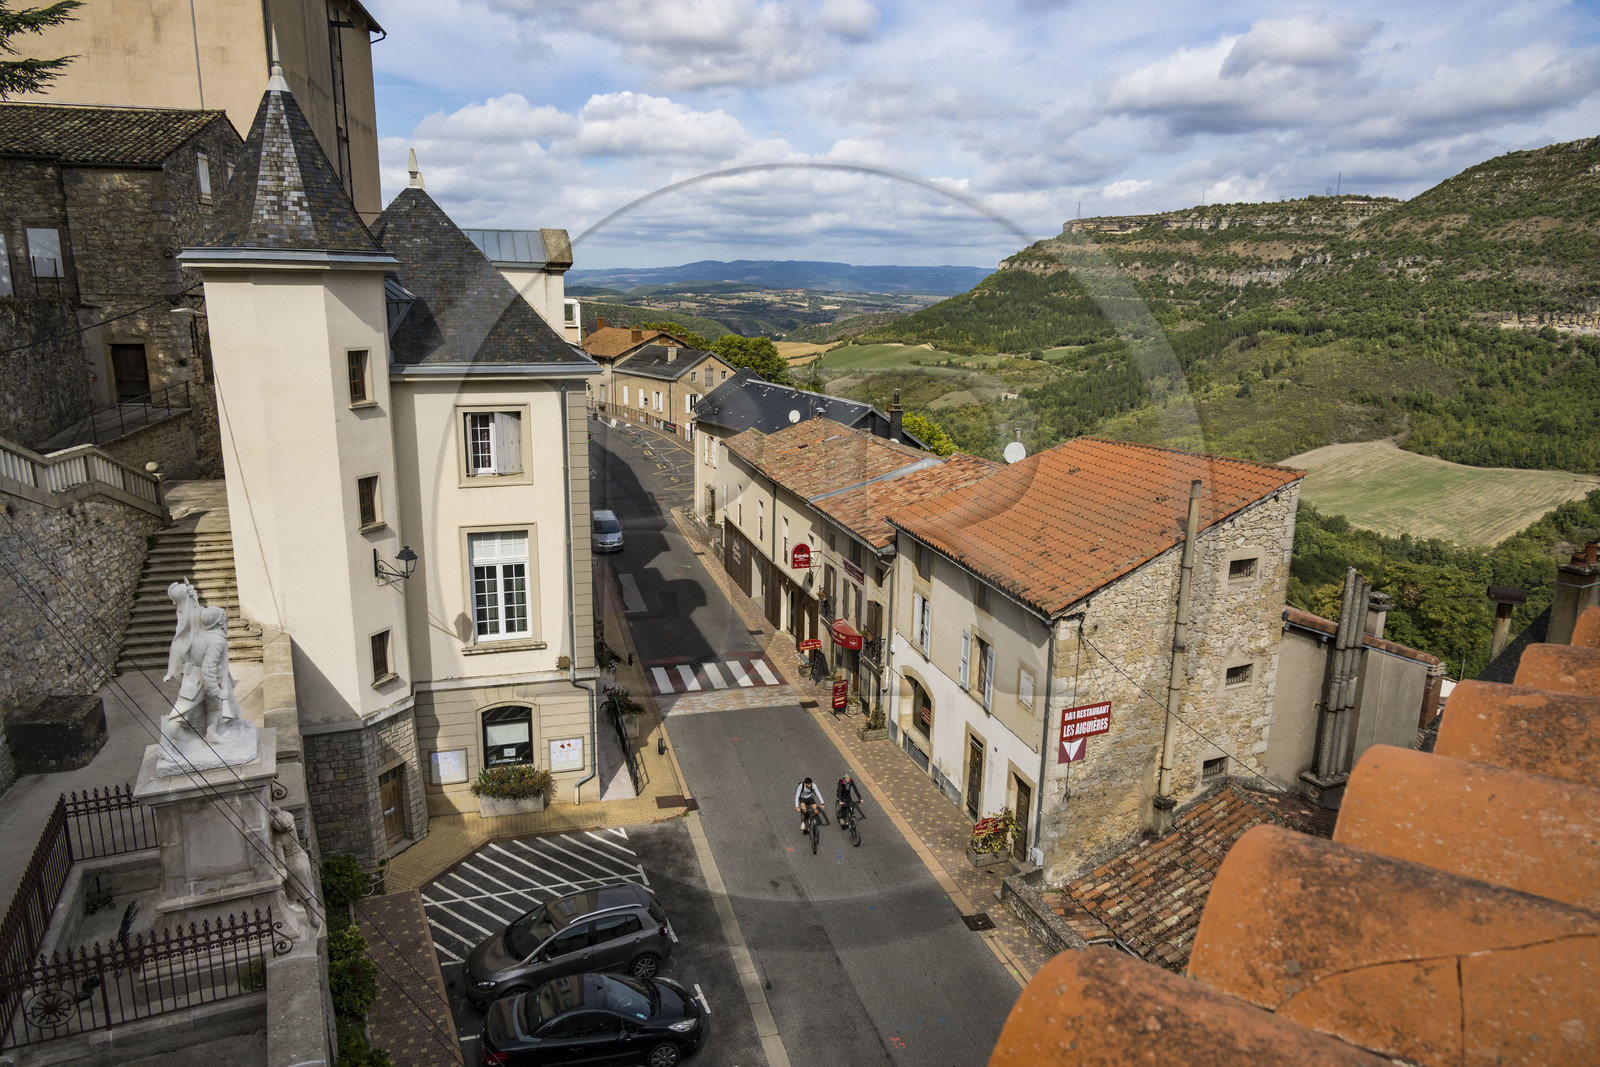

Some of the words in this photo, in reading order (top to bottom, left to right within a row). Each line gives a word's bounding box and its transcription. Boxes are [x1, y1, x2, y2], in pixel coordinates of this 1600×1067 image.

[1065, 711, 1076, 721] BAR
[1077, 705, 1109, 718] RESTAURANT
[1063, 724, 1075, 738] LES
[1075, 717, 1108, 735] AIGUIÈRES
